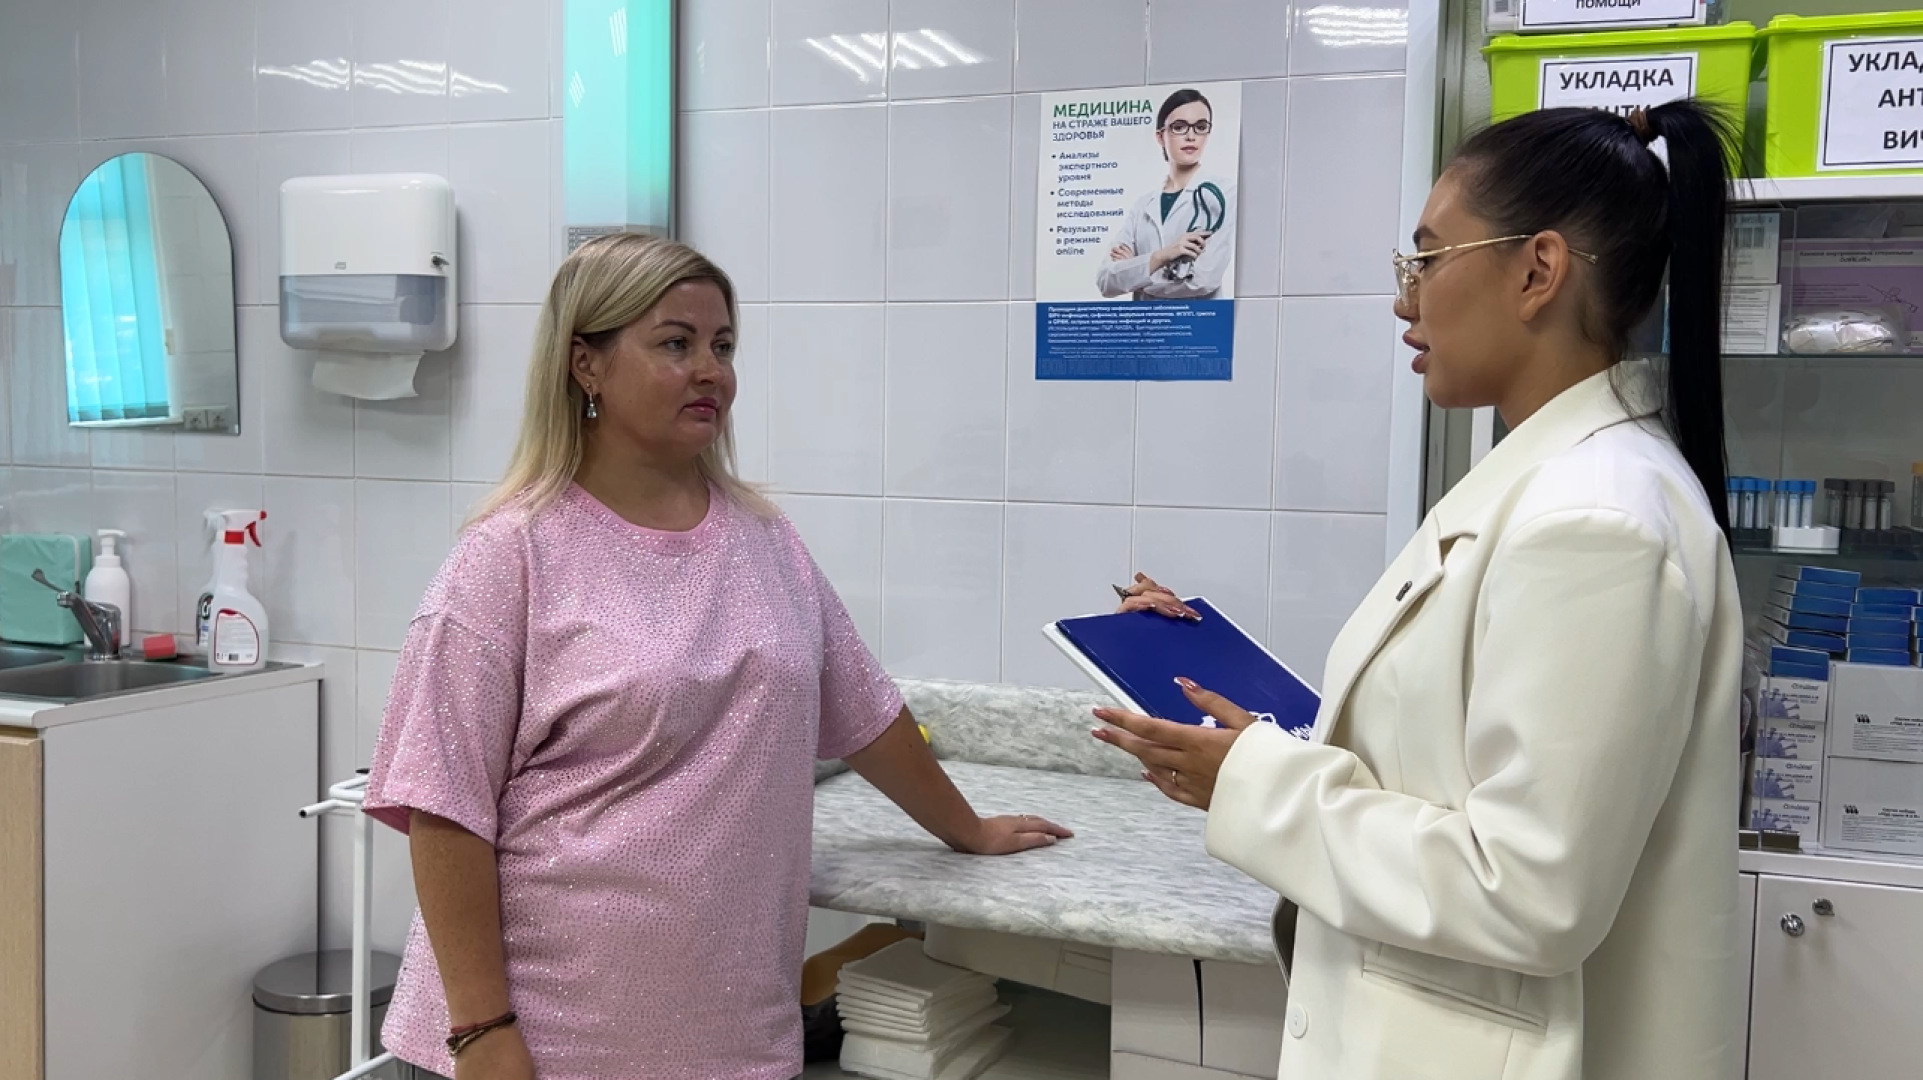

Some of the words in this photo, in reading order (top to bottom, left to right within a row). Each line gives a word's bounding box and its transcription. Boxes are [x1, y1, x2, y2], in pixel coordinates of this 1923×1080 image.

[1560, 68, 1674, 92] УКЛАДКА
[1053, 99, 1153, 117] МЕДИЦИНА
[1053, 121, 1066, 130] НА
[1068, 119, 1108, 129] СТРАЖЕ
[1111, 117, 1152, 127] ВАШЕГО
[1053, 131, 1104, 142] ЗДОРОВЬЯ
[1883, 130, 1923, 150] ВИ
[1059, 151, 1099, 160] Анализы
[1058, 161, 1118, 171] экспертного
[1058, 174, 1091, 183] уровня
[1058, 187, 1124, 197] Современные
[1057, 200, 1093, 208] методы
[1057, 208, 1124, 218] исследований
[1056, 226, 1108, 235] Результаты
[1064, 237, 1101, 246] режиме
[1056, 247, 1084, 256] online
